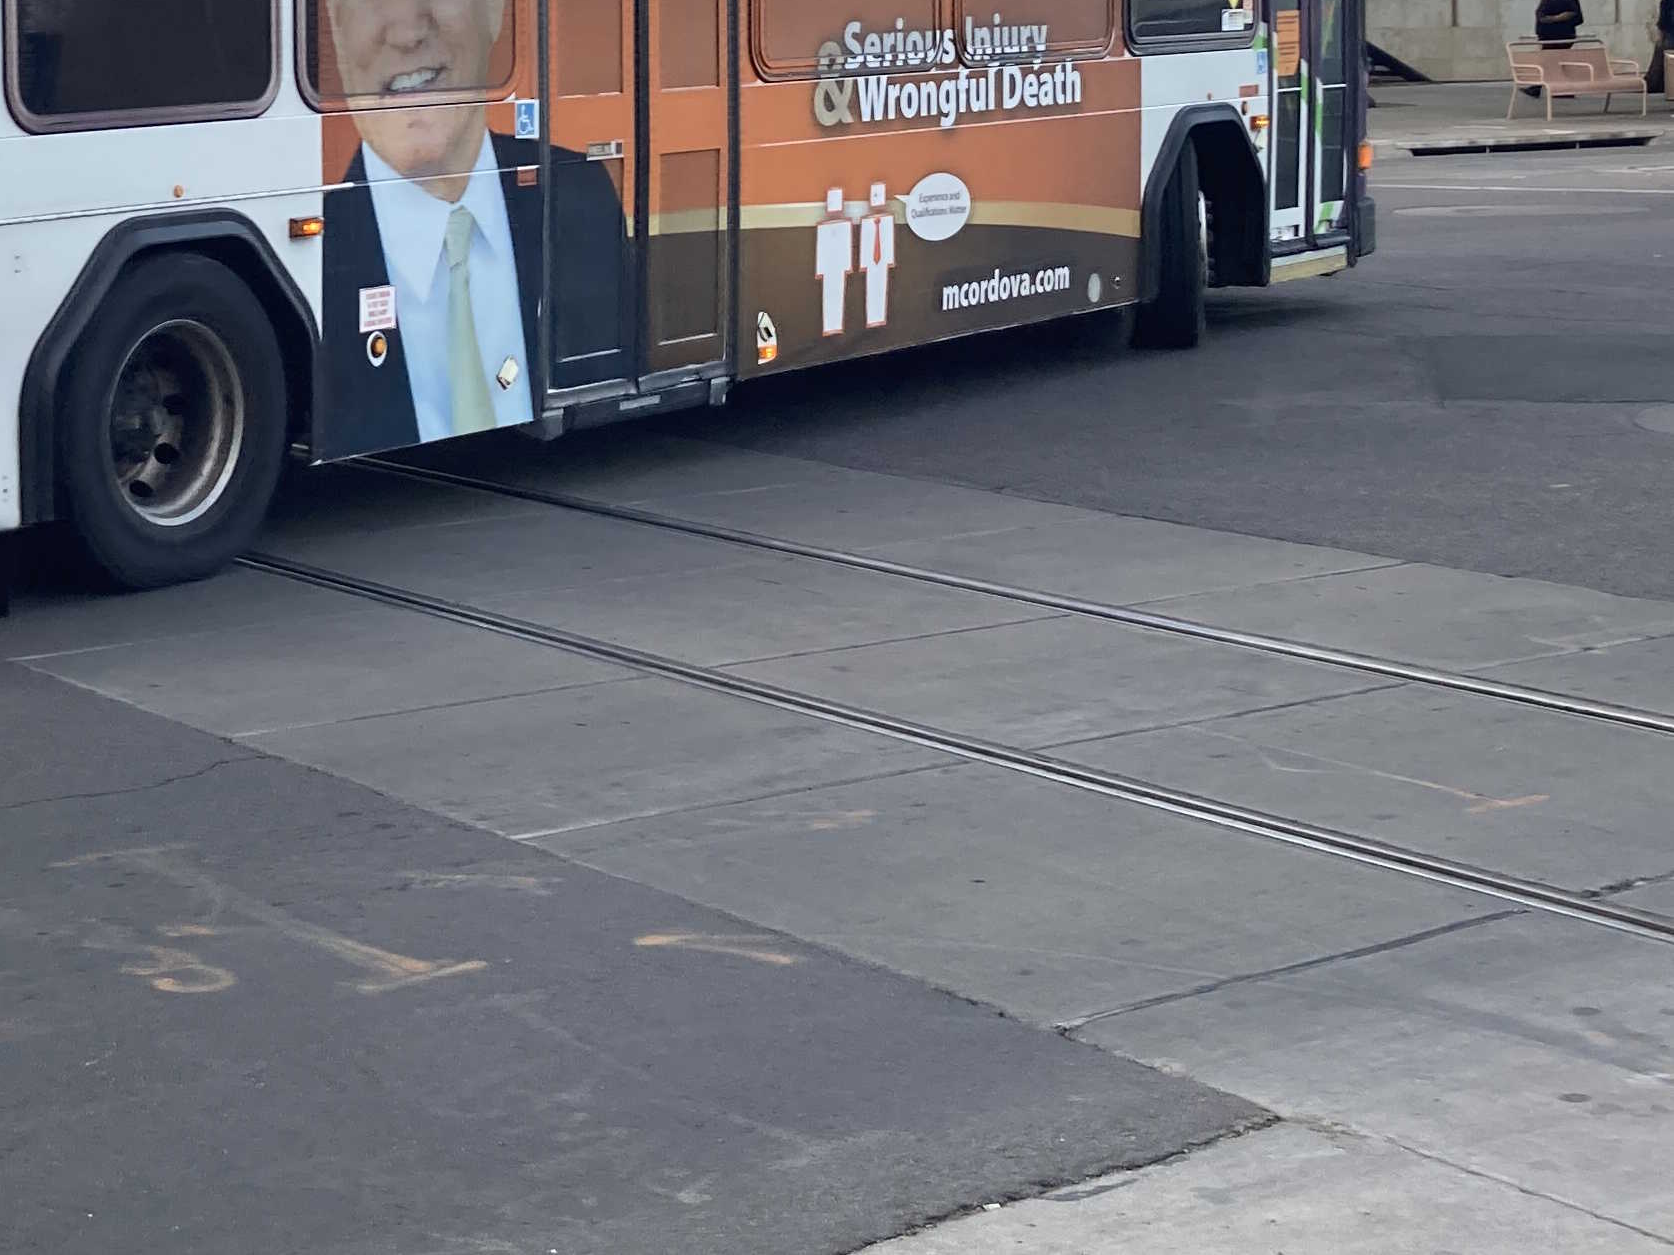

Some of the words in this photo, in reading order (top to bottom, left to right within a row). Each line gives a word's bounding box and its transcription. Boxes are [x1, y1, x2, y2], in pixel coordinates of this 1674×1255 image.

[844, 18, 956, 69] Serious
[965, 12, 1048, 71] Injury
[814, 39, 855, 128] &
[856, 63, 996, 128] Wrongful
[1002, 57, 1082, 109] Death
[942, 262, 1072, 313] mcordova.com
